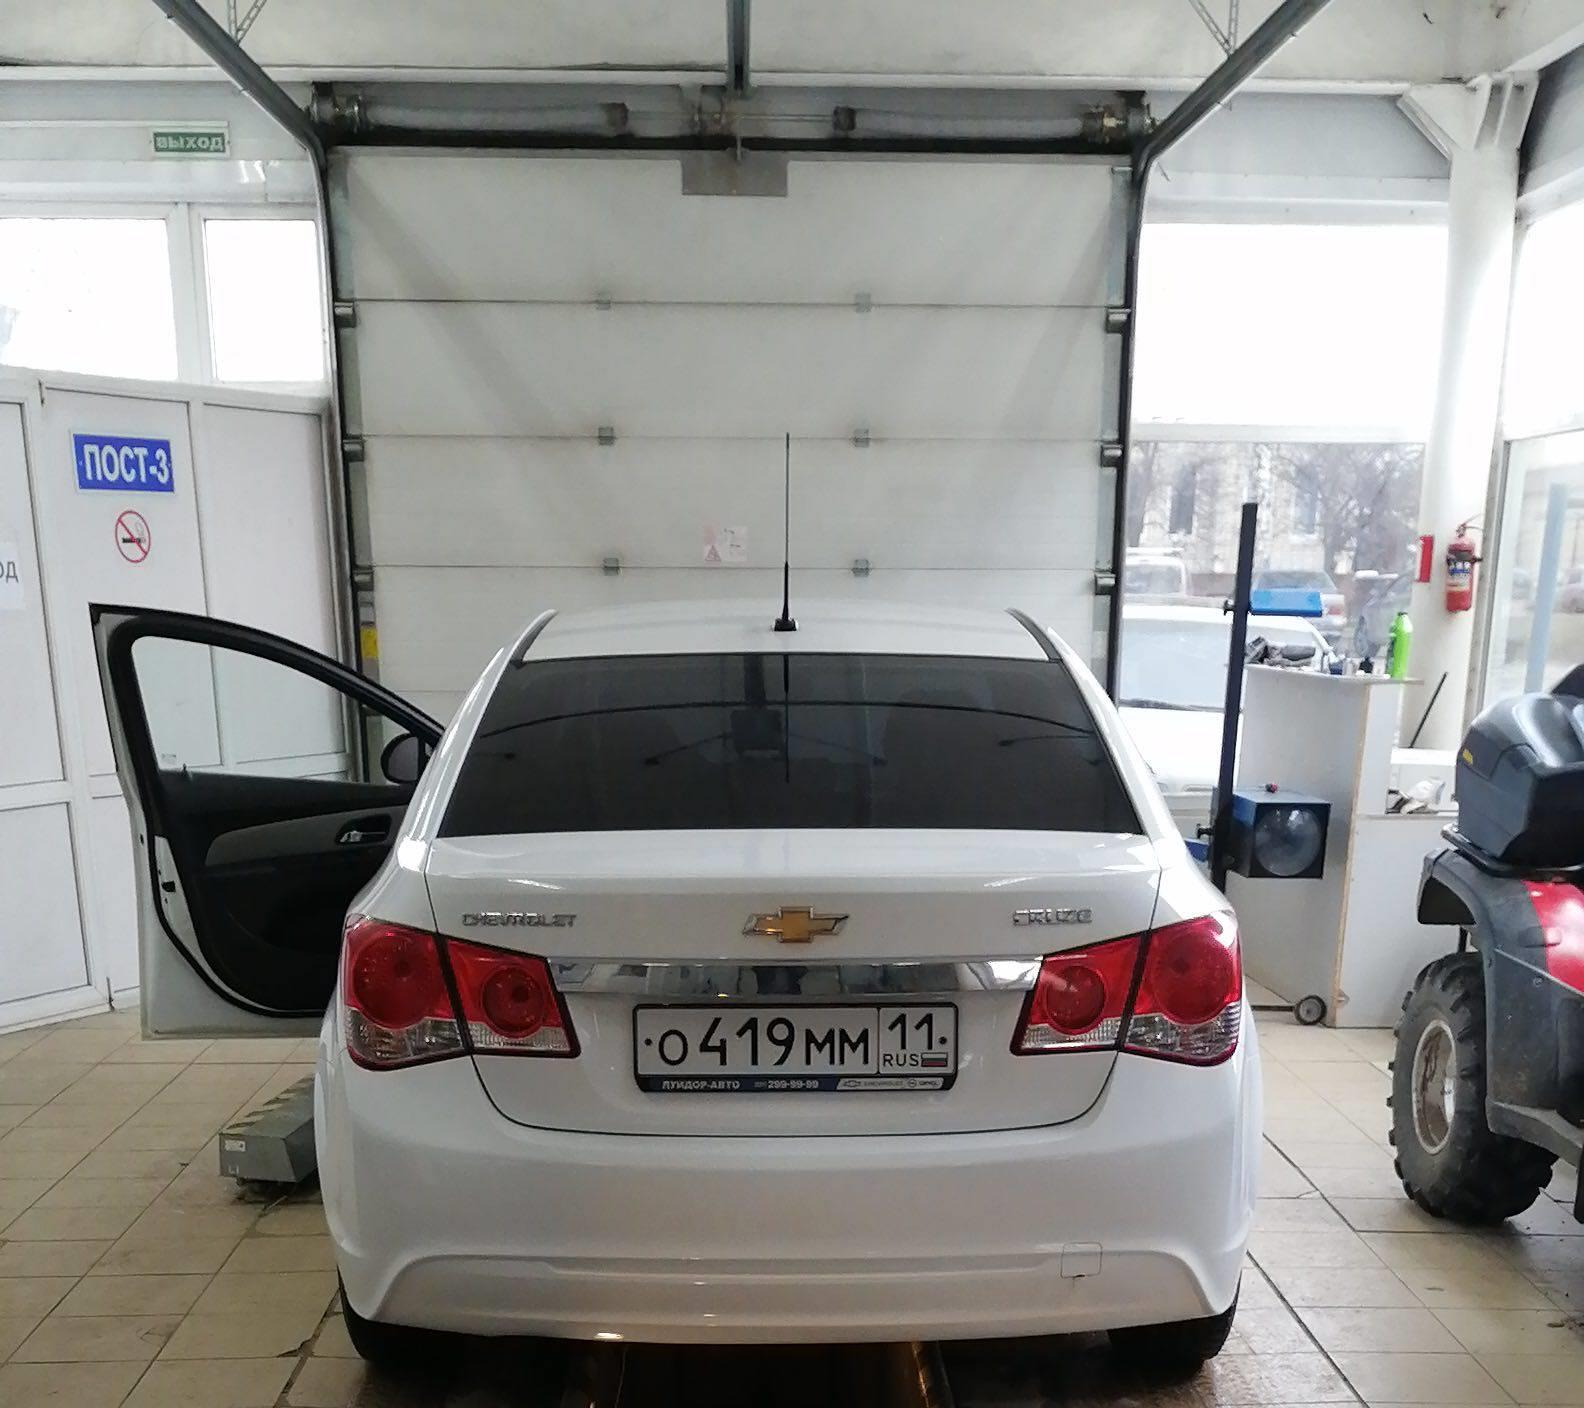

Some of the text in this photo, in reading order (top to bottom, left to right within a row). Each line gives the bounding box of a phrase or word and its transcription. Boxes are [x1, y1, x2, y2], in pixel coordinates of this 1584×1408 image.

[156, 136, 223, 151] ВЫХОД
[84, 444, 169, 483] ПОСТ-3
[462, 912, 576, 927] CHEVROLET
[888, 1013, 933, 1050] 11
[882, 1053, 919, 1067] RUS
